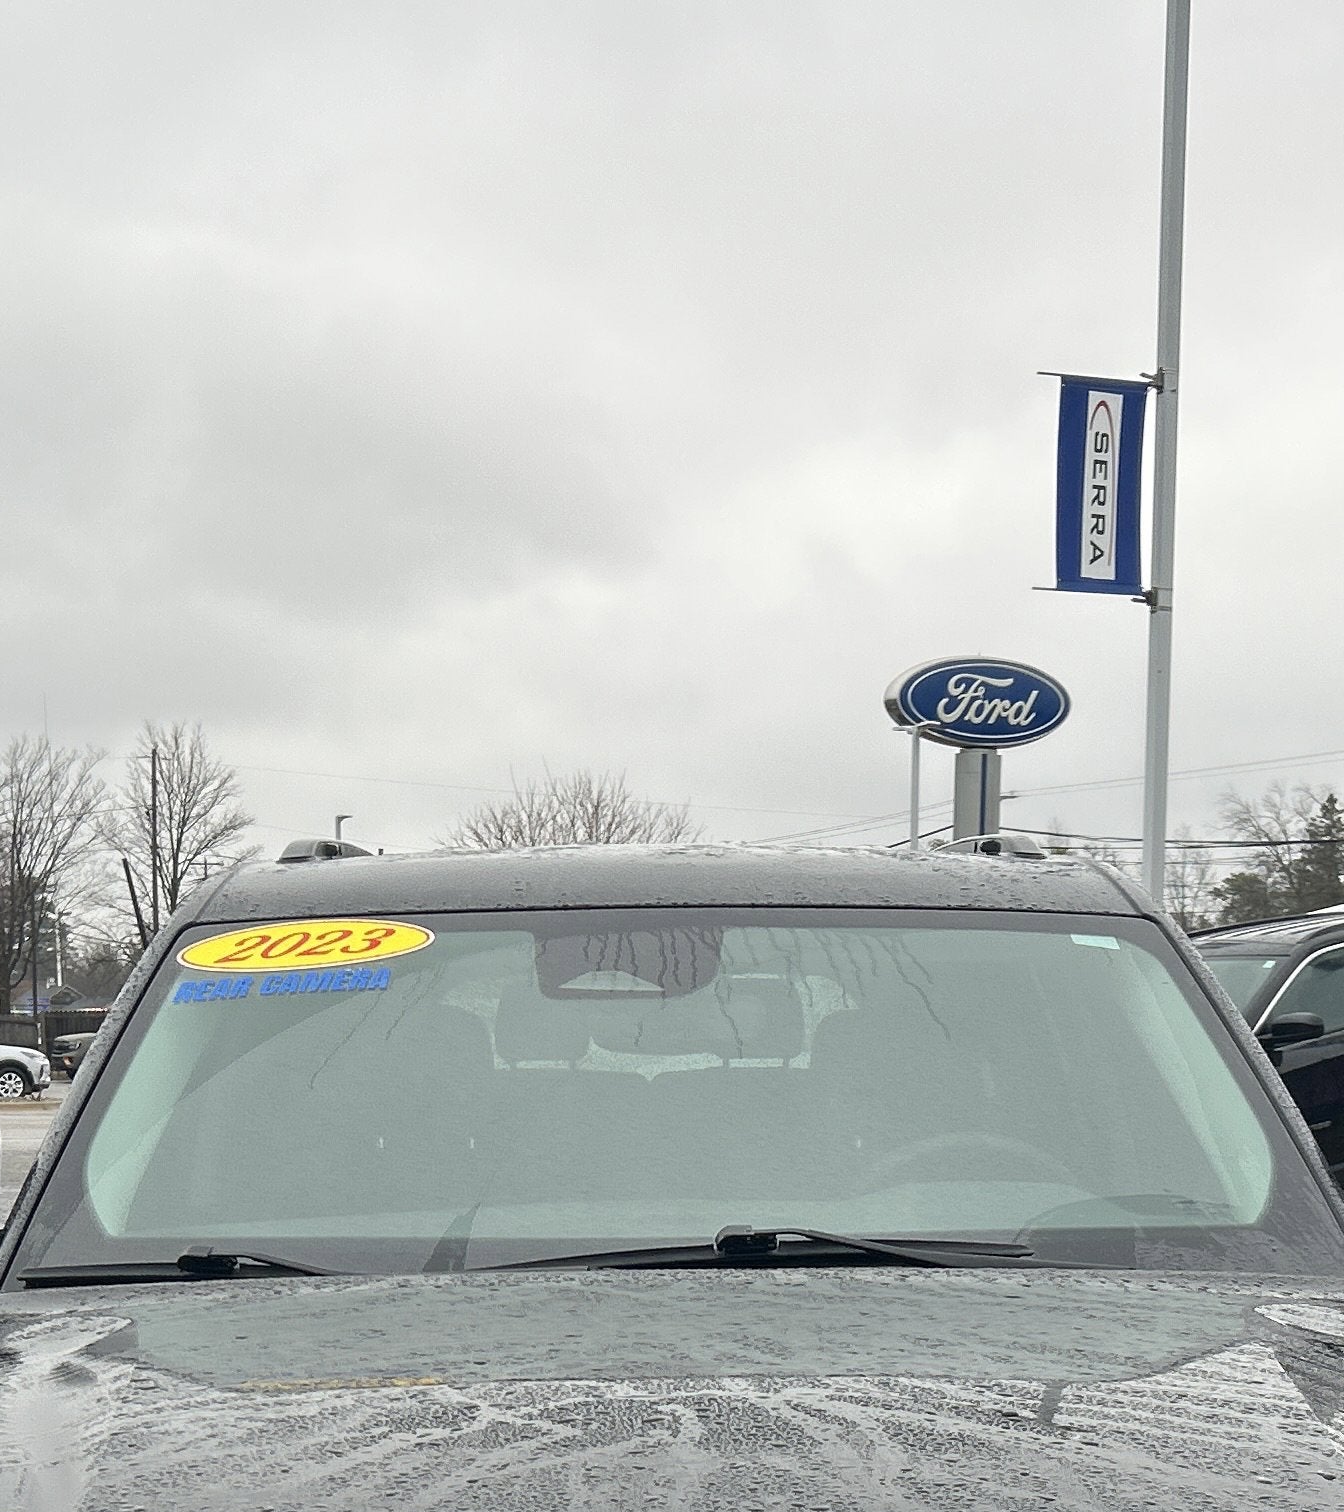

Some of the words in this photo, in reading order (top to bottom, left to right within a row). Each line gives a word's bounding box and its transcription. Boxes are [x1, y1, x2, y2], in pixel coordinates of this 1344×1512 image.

[1088, 431, 1109, 566] SERRA
[936, 673, 1040, 727] Ford
[213, 928, 396, 964] 2023
[173, 975, 254, 1004] REAR
[259, 967, 391, 996] CAMERA
